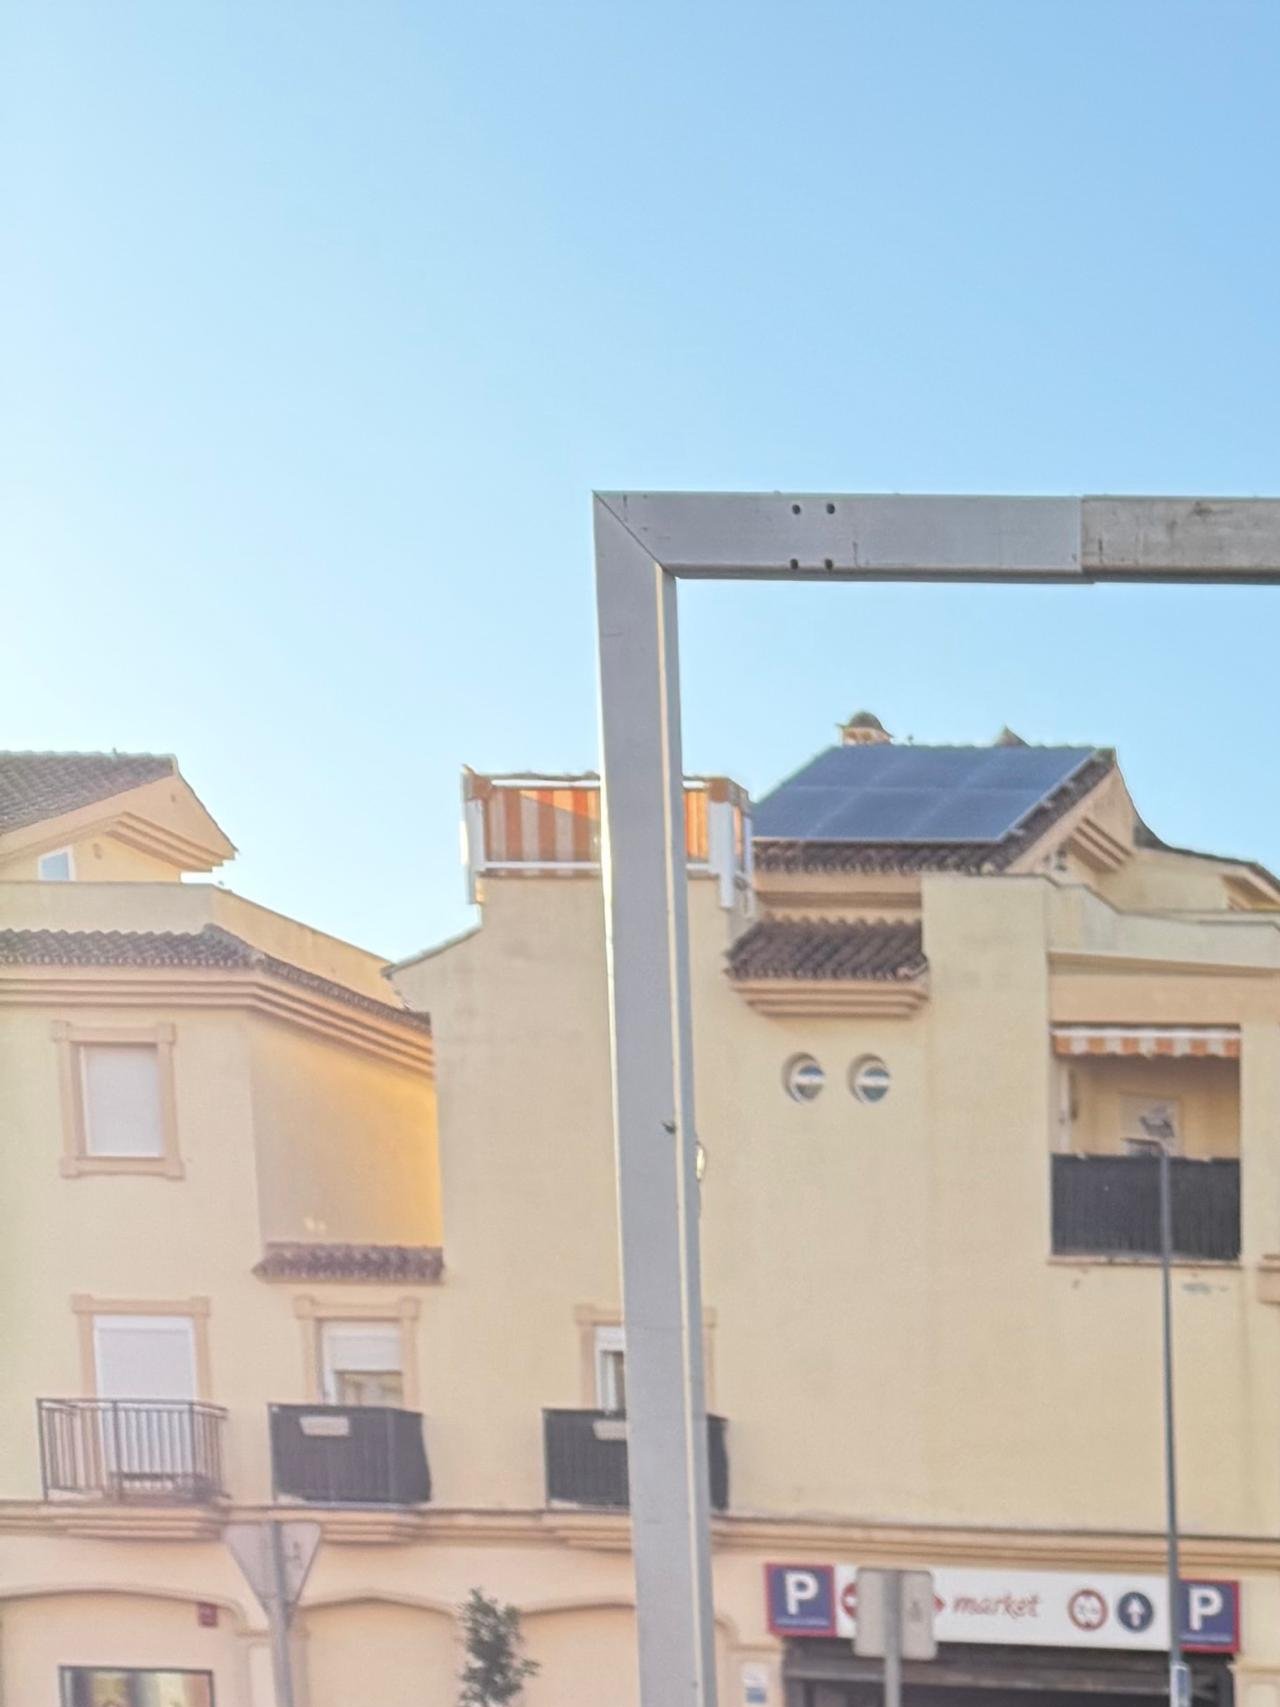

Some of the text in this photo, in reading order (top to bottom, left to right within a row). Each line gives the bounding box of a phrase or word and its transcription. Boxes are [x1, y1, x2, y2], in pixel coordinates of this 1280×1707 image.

[764, 1474, 905, 1498] Cruzcampo
[785, 1570, 820, 1615] P
[953, 1594, 1039, 1619] market
[1188, 1587, 1223, 1631] P
